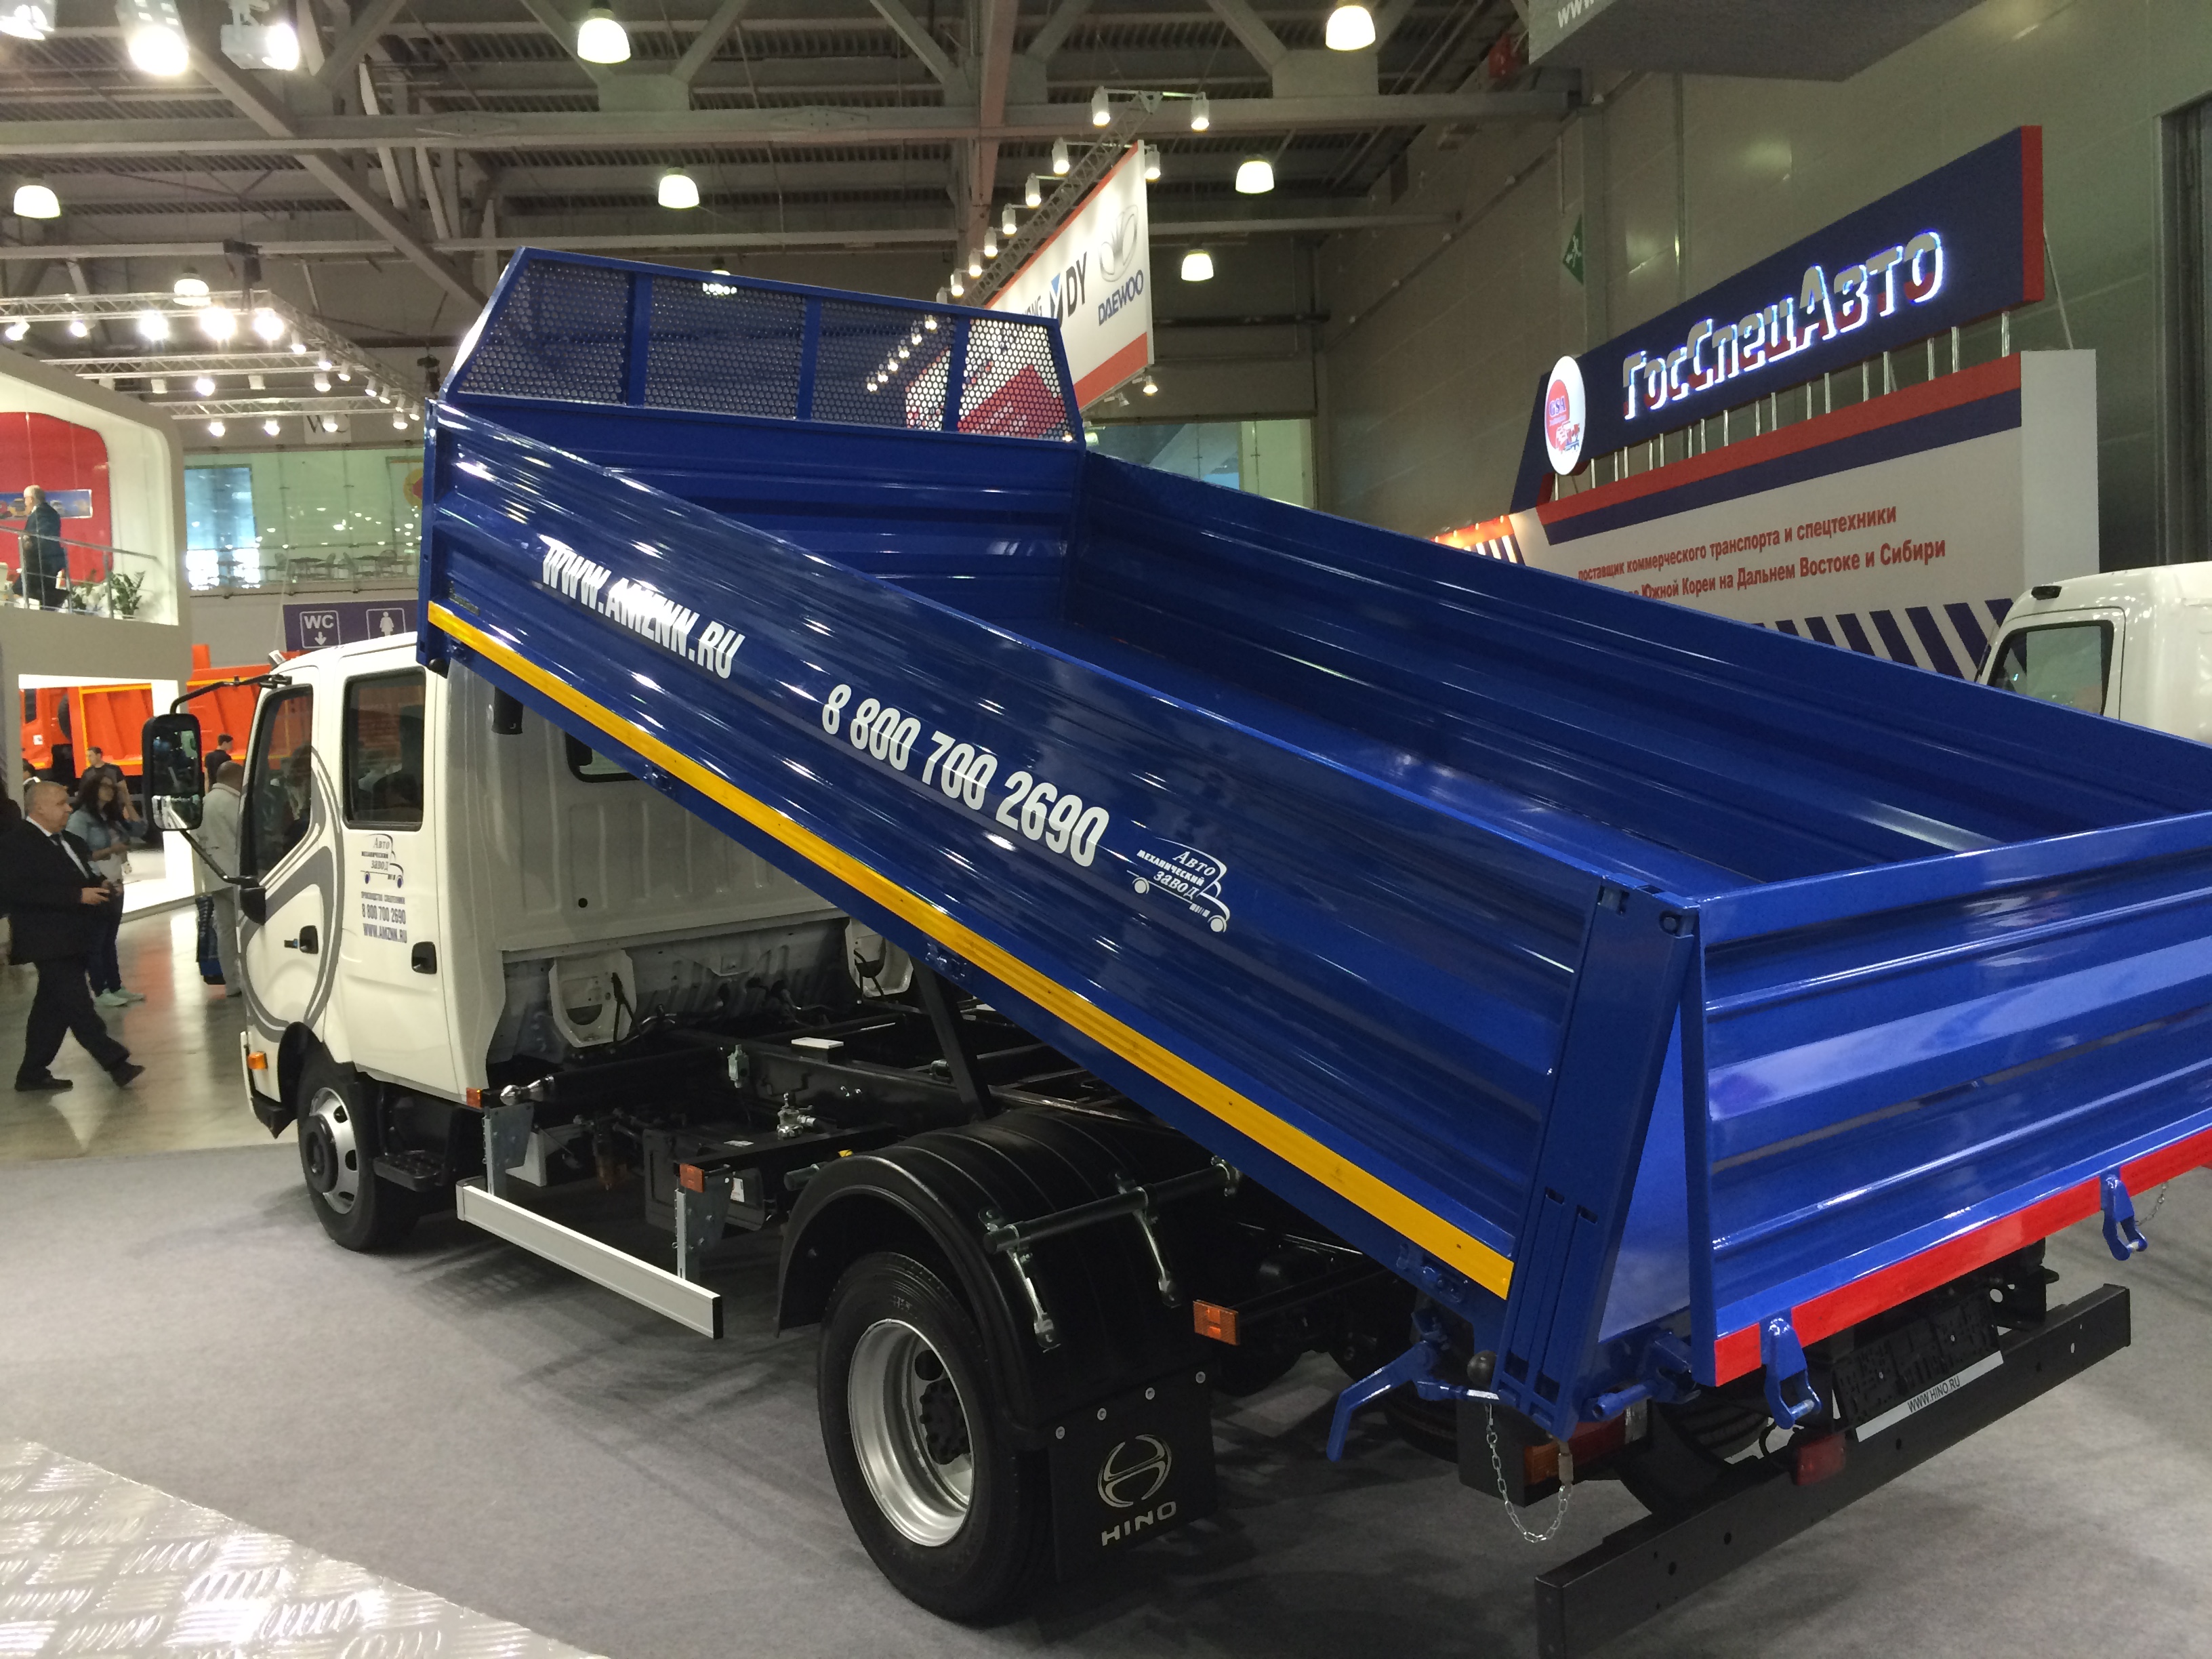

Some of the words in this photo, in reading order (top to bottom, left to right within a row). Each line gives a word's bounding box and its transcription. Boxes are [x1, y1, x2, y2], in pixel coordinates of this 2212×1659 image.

[1065, 251, 1087, 318] DY
[1098, 270, 1144, 326] DAEWOO
[1578, 562, 1625, 581] поставщик
[1626, 545, 1707, 571] коммерческого
[1709, 529, 1780, 560] транспорта
[1784, 527, 1793, 542] и
[1797, 506, 1897, 538] спецтехники
[1641, 578, 1679, 600] Южной
[1682, 577, 1716, 597] Кореи
[1719, 574, 1734, 589] на
[1737, 564, 1796, 590] Дальнем
[1799, 553, 1860, 577] Востоке
[1865, 551, 1875, 568] и
[1880, 539, 1946, 565] Сибири
[304, 615, 334, 629] WC
[821, 684, 852, 735] 8
[850, 698, 922, 771] 800
[922, 730, 998, 811] 700
[995, 771, 1110, 867] 2690
[1136, 849, 1206, 886] МЕХАНИЧЕСКИЙ
[362, 903, 366, 918] 8
[367, 904, 377, 920] 800
[378, 906, 390, 922] 700
[391, 907, 406, 924] 2690
[1907, 1375, 1961, 1414] WWW.HINO.RU
[1101, 1501, 1176, 1547] HINO
